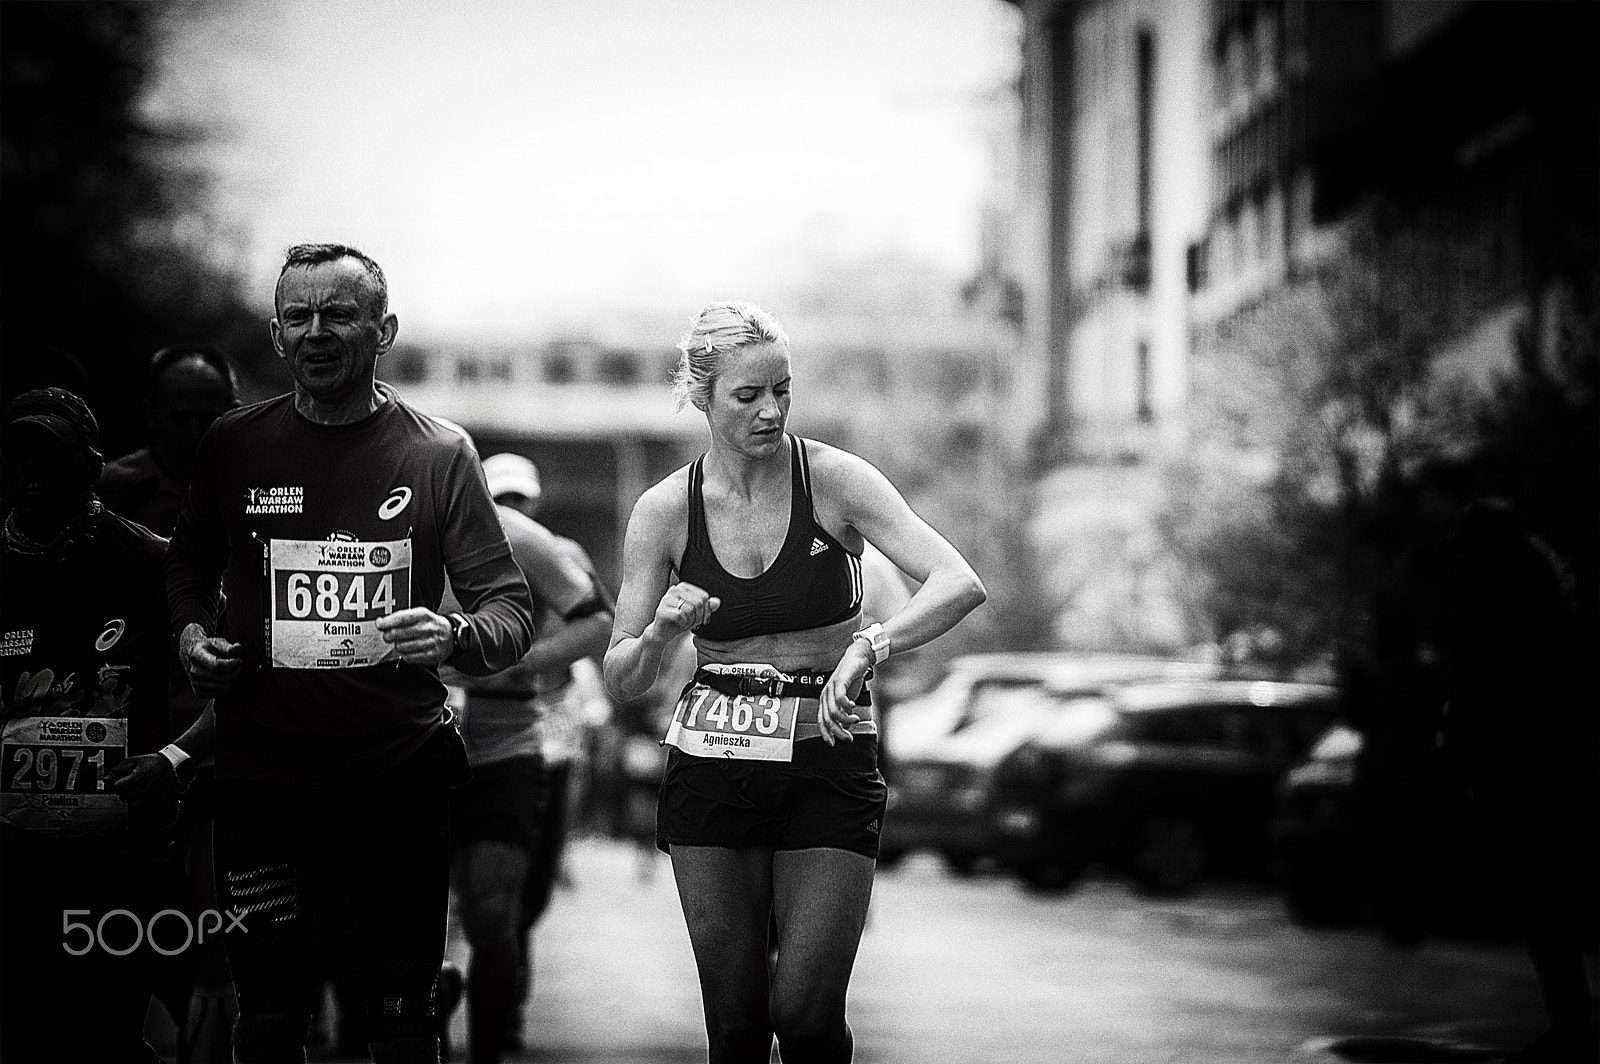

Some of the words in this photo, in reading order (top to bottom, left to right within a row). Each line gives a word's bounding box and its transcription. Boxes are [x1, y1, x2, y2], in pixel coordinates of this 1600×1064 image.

[270, 486, 304, 496] ORLEN
[258, 496, 304, 504] WARSAW
[246, 504, 304, 514] MARATHON
[318, 560, 365, 568] MARATHON
[287, 572, 396, 619] 6844
[323, 623, 362, 635] Kamila
[4, 630, 34, 640] ORLEN
[686, 689, 781, 734] 7463
[702, 734, 751, 748] Agnieszka
[10, 748, 106, 790] 2971
[42, 795, 79, 806] Paulina
